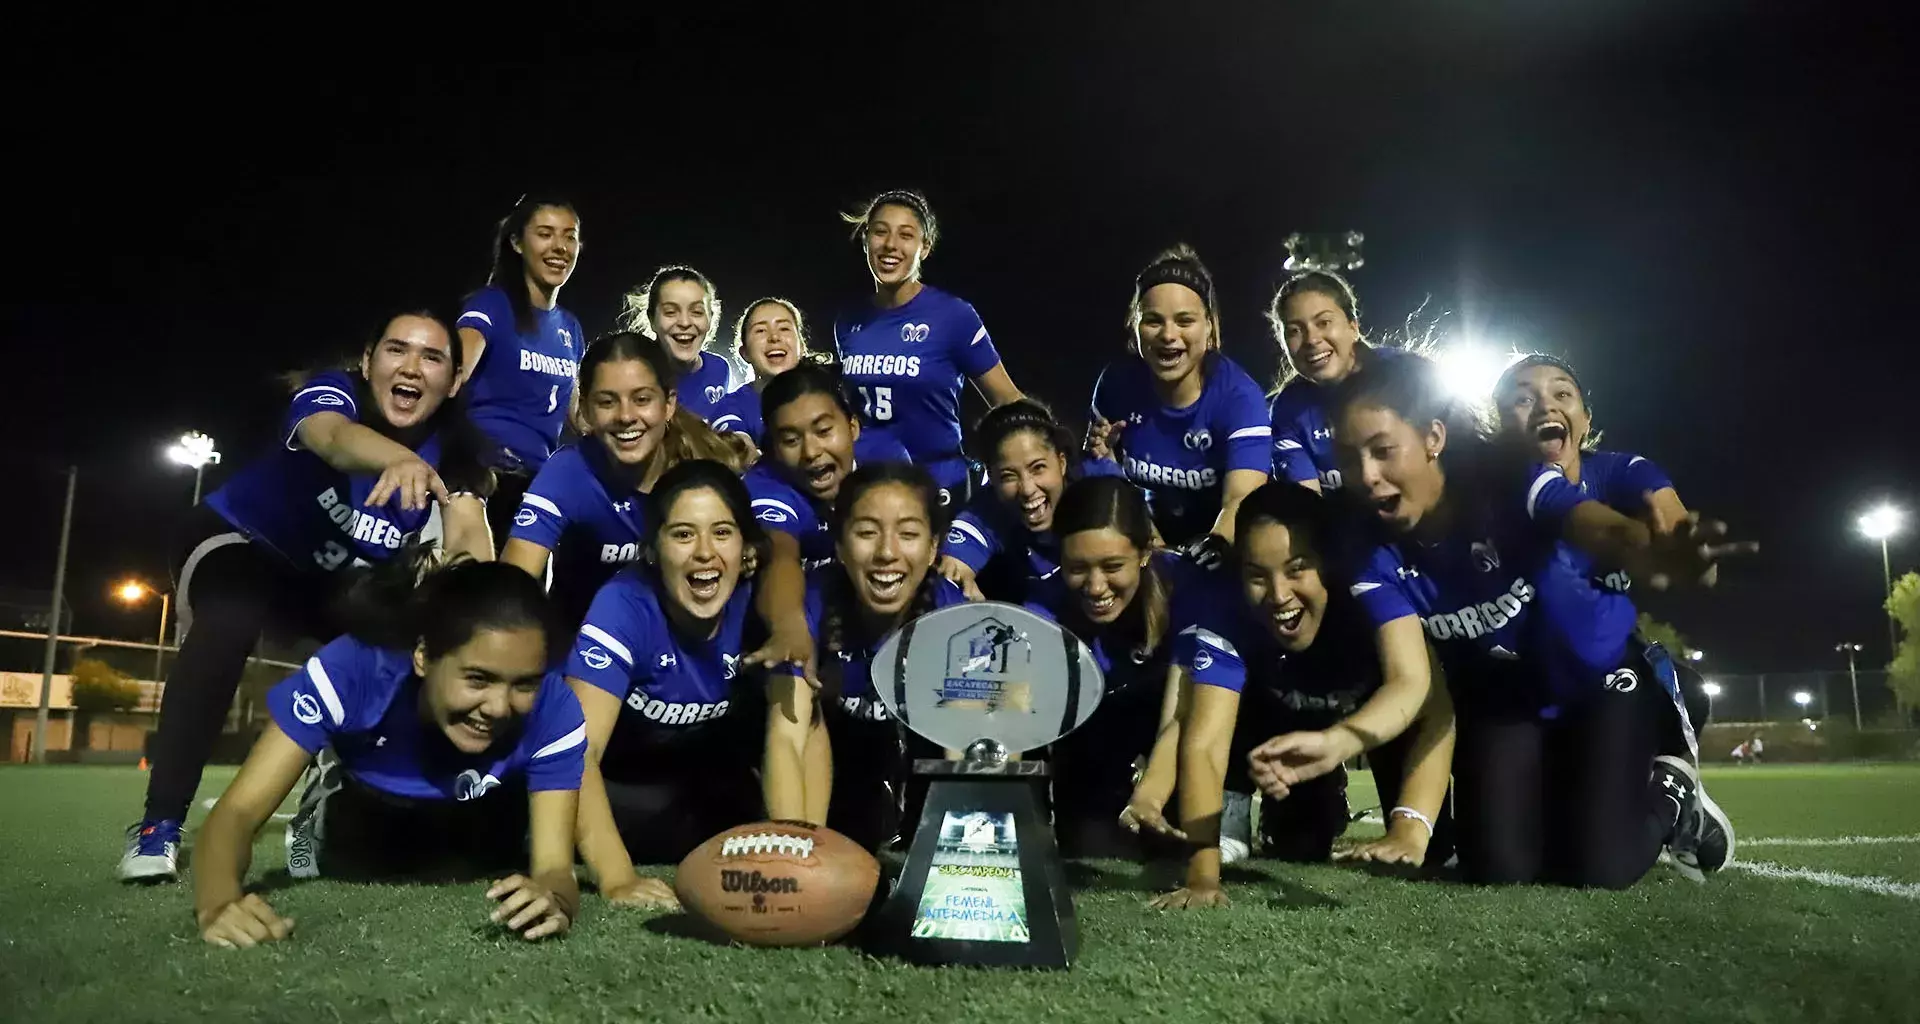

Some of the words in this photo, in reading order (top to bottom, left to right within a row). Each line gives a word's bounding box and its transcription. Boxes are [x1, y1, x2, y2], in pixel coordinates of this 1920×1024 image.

[842, 355, 920, 377] ORREGOS
[858, 387, 893, 420] 15
[1122, 449, 1217, 490] ORREGOS
[945, 895, 1000, 908] FEMENIL
